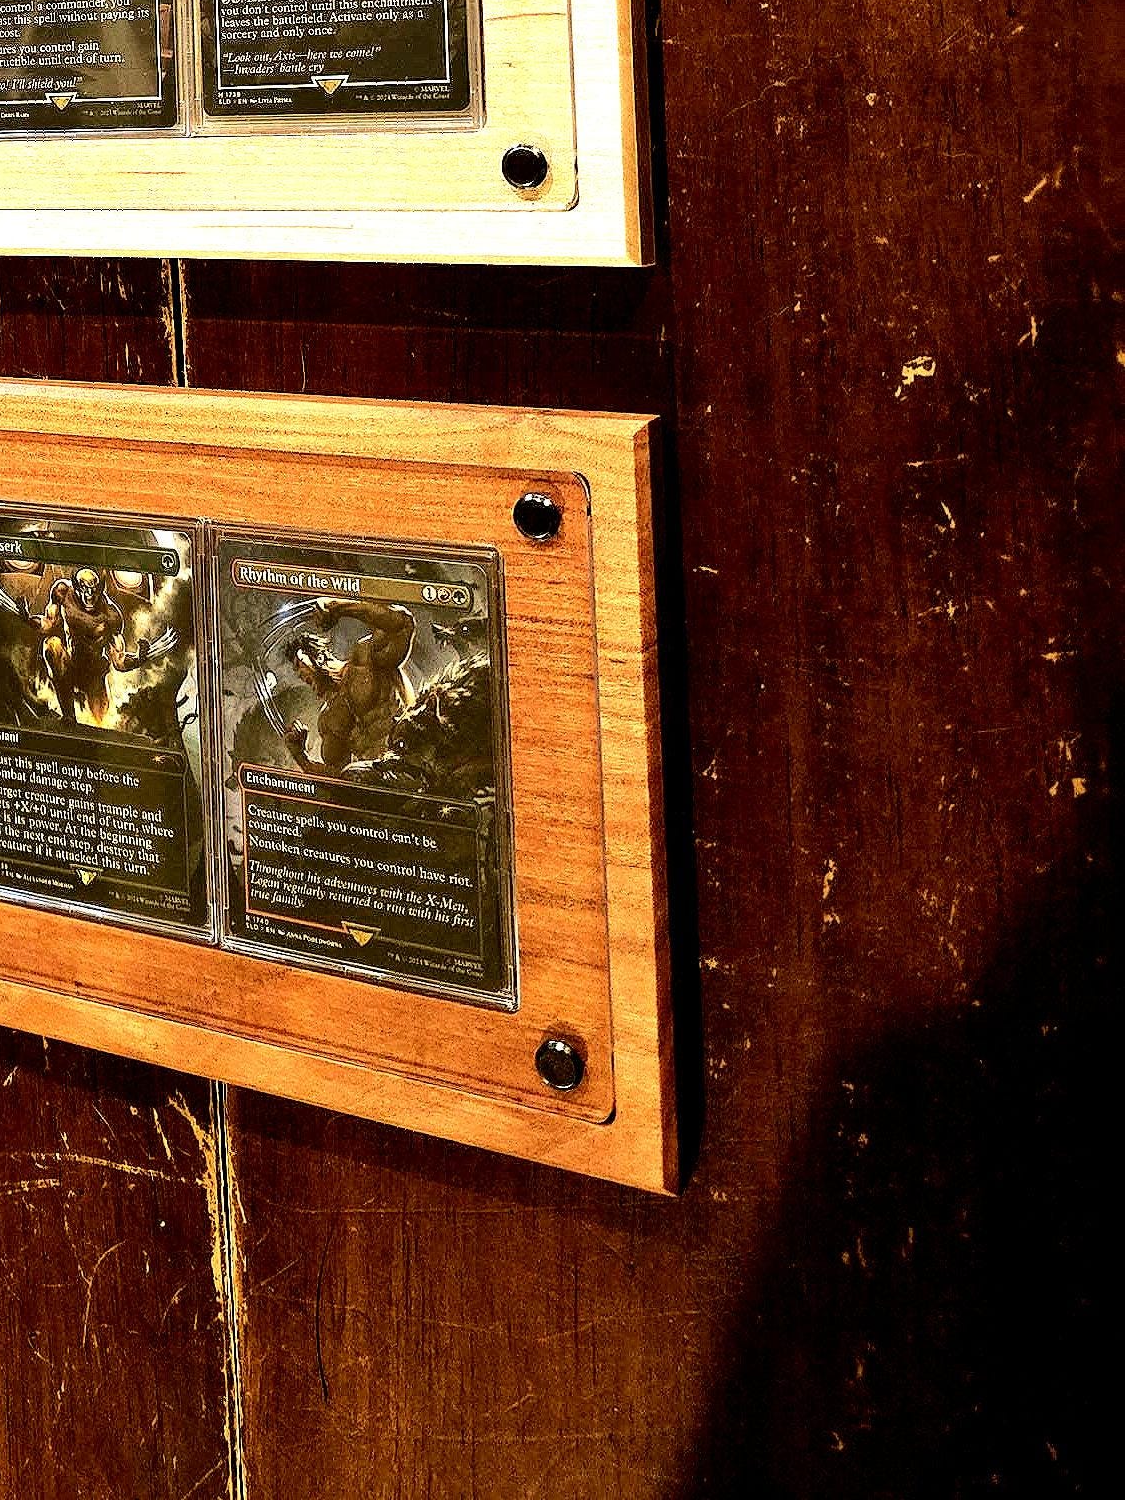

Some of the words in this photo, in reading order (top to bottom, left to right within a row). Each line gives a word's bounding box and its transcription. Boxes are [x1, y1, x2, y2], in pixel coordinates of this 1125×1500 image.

[0, 1, 33, 13] control
[220, 7, 239, 18] you
[240, 3, 269, 14] don't
[271, 1, 308, 13] control
[309, 0, 335, 11] until
[337, 0, 359, 10] this
[13, 14, 32, 25] this
[33, 12, 56, 26] spell
[58, 11, 99, 22] without
[100, 9, 135, 23] paying
[136, 8, 149, 18] its
[221, 17, 250, 27] leaves
[251, 15, 270, 26] the
[328, 11, 373, 23] Activate
[375, 10, 400, 23] only
[220, 31, 258, 40] sorcery
[260, 27, 280, 38] and
[281, 26, 305, 39] only
[17, 46, 36, 57] you
[37, 41, 74, 53] control
[76, 41, 99, 54] gain
[38, 54, 61, 66] until
[62, 54, 82, 65] end
[239, 566, 287, 585] Rhythm
[307, 574, 328, 589] the
[330, 576, 360, 592] Wild
[14, 757, 32, 770] this
[34, 762, 58, 775] spell
[60, 765, 85, 781] only
[86, 767, 121, 784] before
[122, 774, 141, 787] the
[246, 772, 315, 793] Enchantment
[247, 805, 293, 824] Creature
[295, 816, 324, 830] spells
[326, 821, 347, 835] you
[348, 825, 388, 841] control
[390, 832, 420, 846] can't
[248, 835, 300, 855] Nontoken
[302, 848, 351, 865] creatures
[352, 857, 374, 870] you
[375, 861, 416, 876] control
[417, 865, 446, 882] have
